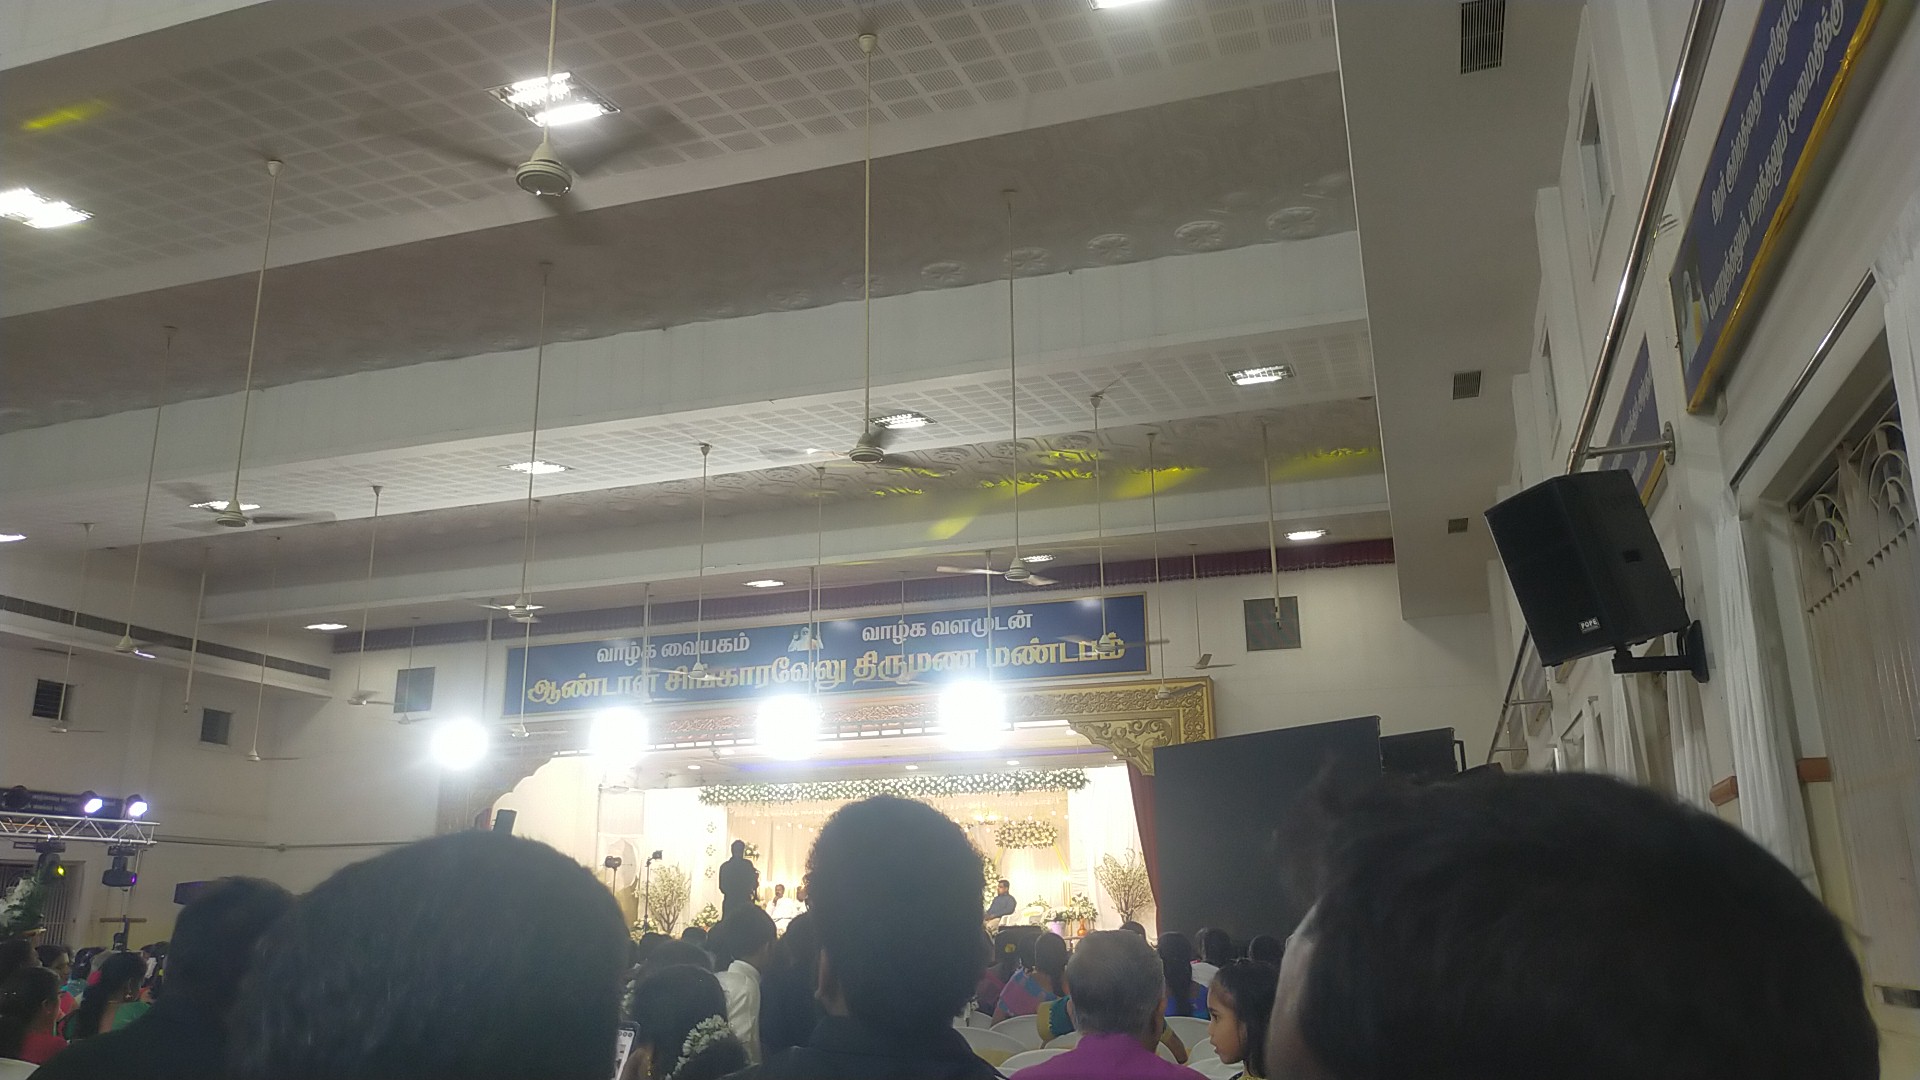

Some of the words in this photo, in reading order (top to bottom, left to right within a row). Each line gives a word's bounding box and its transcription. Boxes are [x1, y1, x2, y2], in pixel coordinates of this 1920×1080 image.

[597, 641, 657, 667] வாழ்க
[661, 631, 750, 658] வையகம்
[862, 620, 927, 645] வாழ்க
[931, 609, 1033, 638] வளமுடன்
[1580, 618, 1598, 630] POPE
